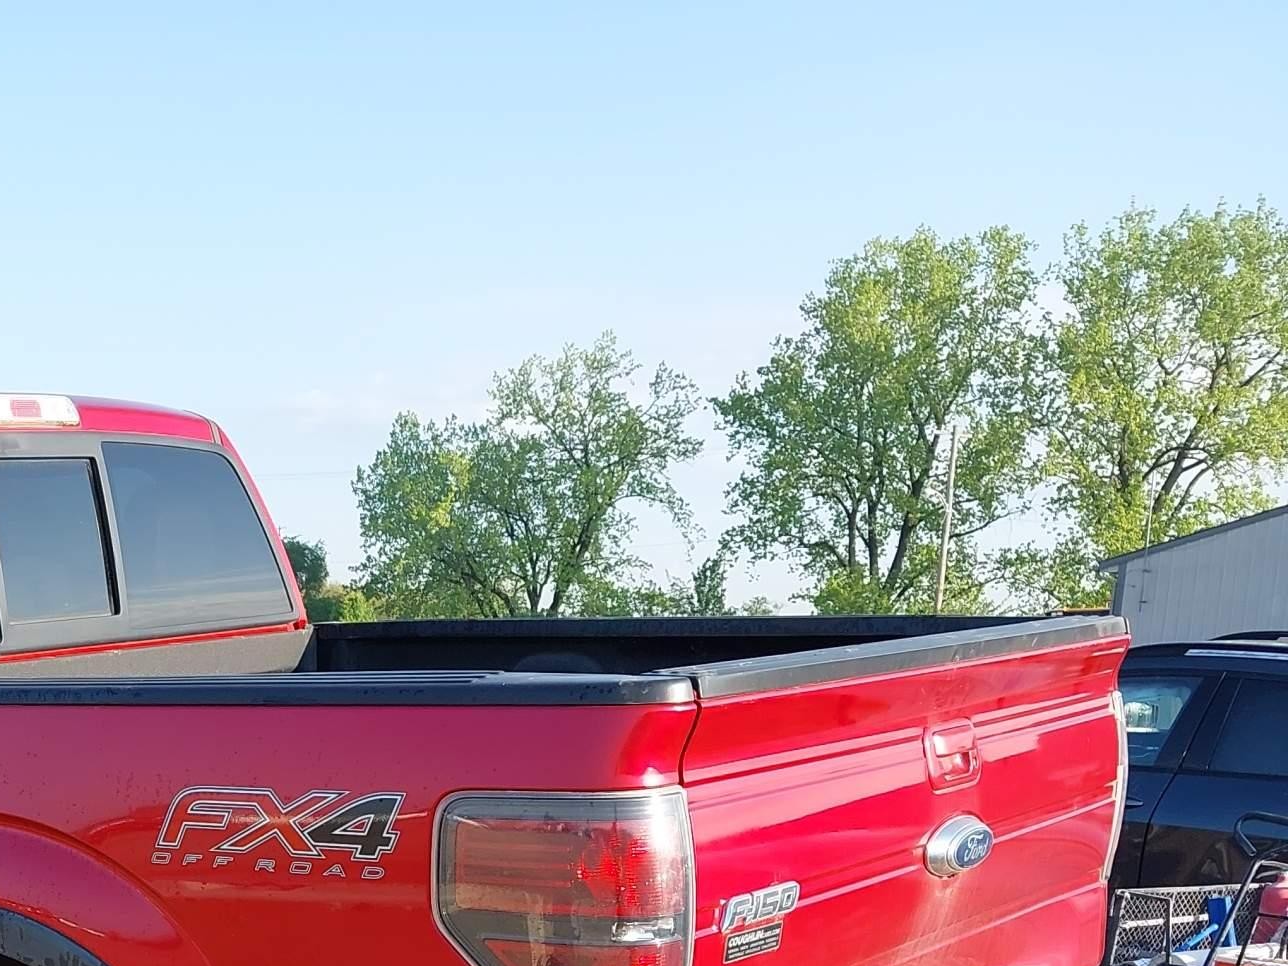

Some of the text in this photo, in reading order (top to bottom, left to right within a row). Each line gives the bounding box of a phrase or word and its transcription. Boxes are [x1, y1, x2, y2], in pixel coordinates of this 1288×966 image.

[155, 786, 407, 863] FX4
[964, 833, 990, 862] Ford
[151, 852, 386, 880] OFF ROAD
